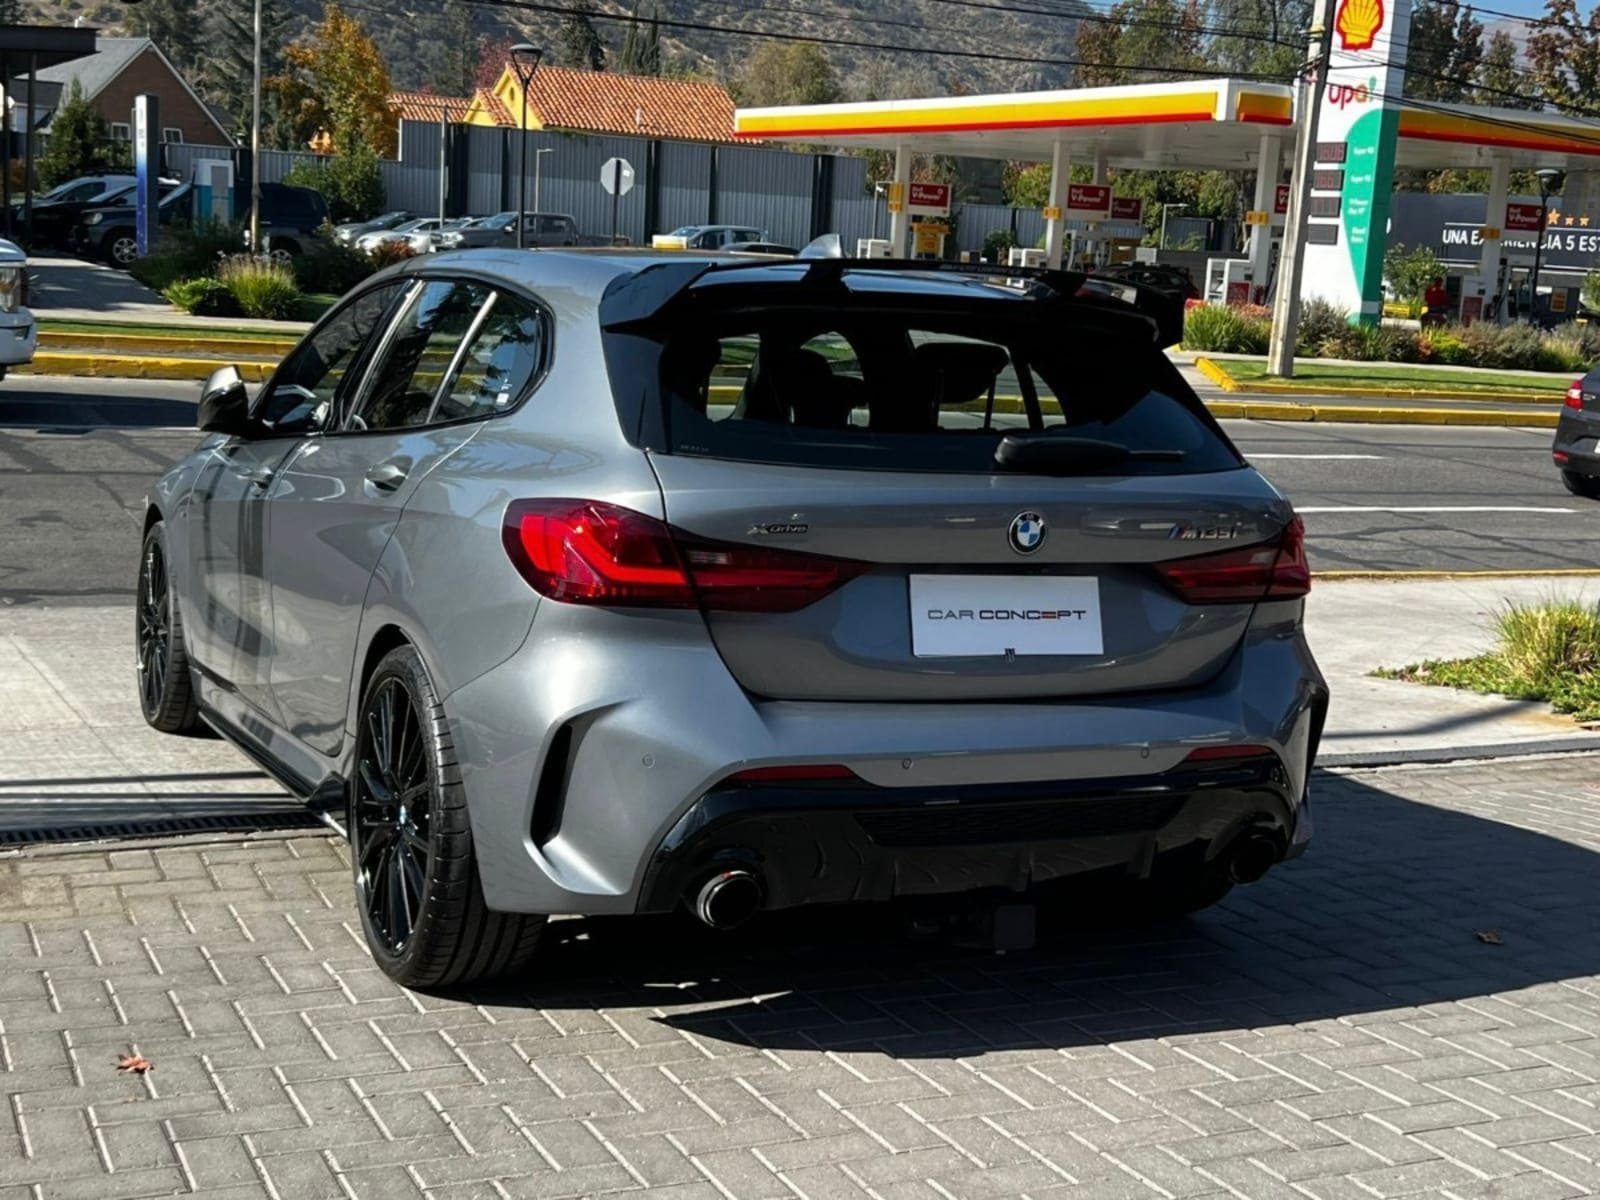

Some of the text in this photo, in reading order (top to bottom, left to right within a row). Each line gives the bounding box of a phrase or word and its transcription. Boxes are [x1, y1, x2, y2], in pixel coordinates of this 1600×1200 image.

[1442, 229, 1468, 245] UNA
[1565, 234, 1576, 251] 5
[927, 609, 1087, 620] CAR CONCEPT
